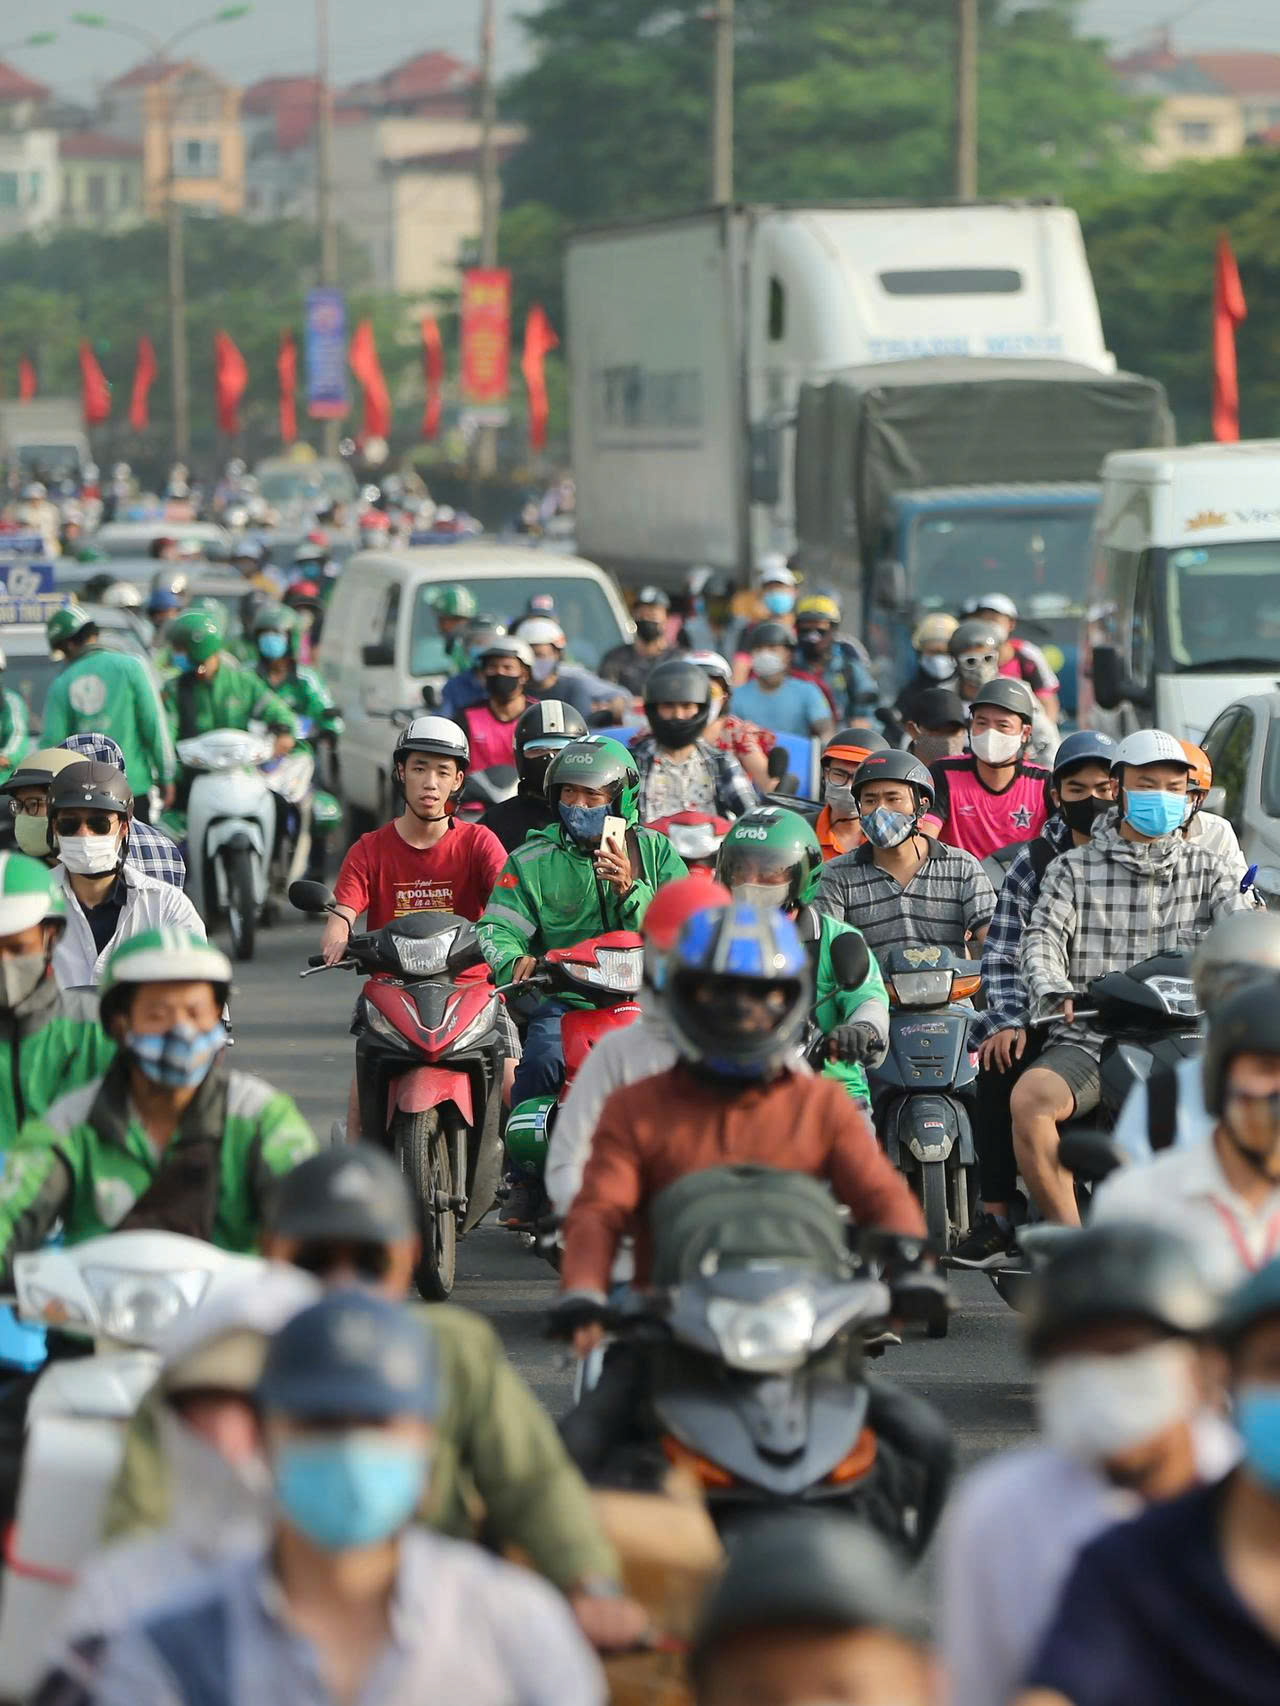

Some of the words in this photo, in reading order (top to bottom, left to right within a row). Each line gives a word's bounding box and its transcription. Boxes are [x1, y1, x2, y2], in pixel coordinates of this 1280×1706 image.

[564, 753, 593, 764] Grab
[735, 827, 768, 840] Grab
[408, 888, 450, 898] DOLLAR
